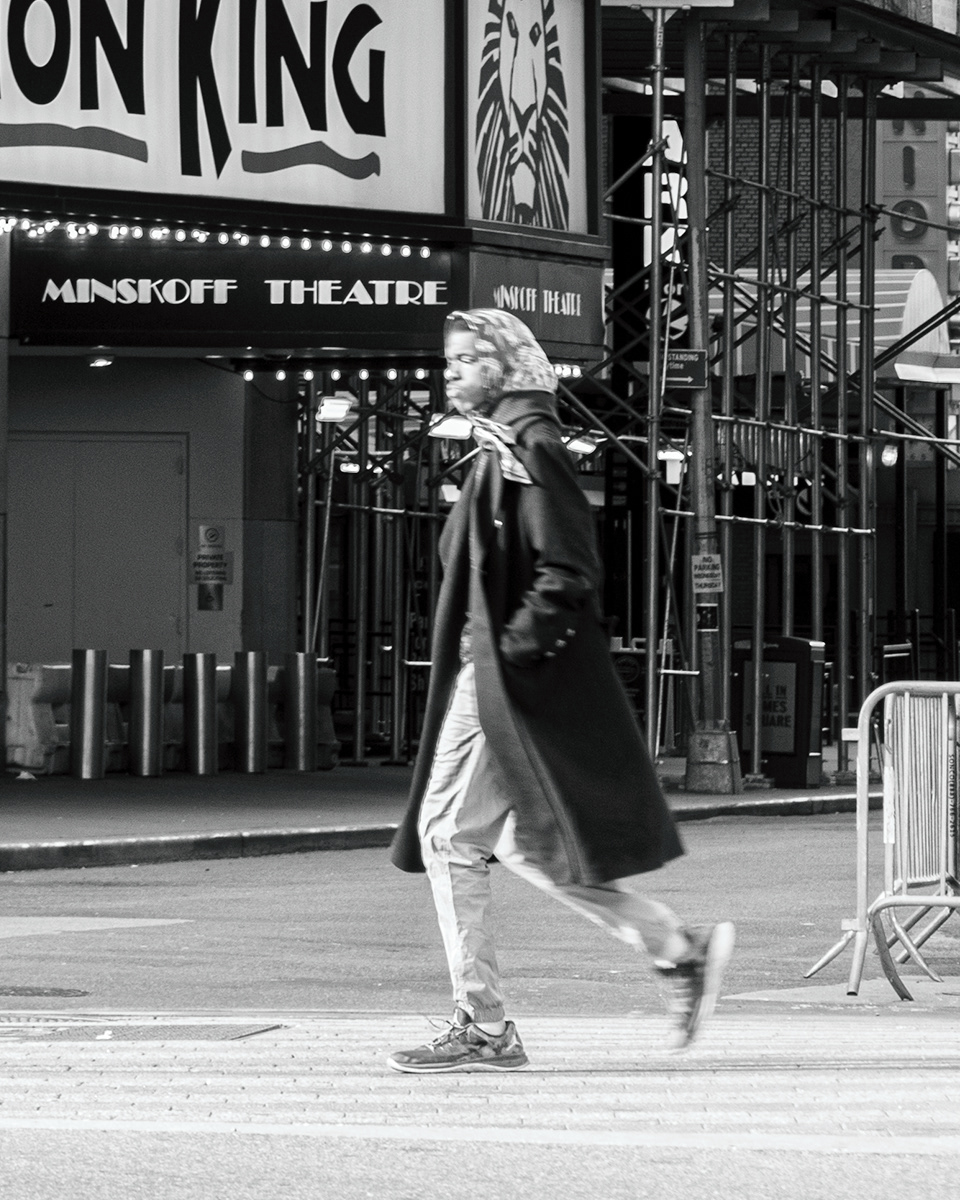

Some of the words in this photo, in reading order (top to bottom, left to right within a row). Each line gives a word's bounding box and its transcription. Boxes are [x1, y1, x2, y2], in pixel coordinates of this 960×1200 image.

[41, 278, 238, 305] MINSKOFF
[264, 279, 448, 306] THEATRE
[746, 712, 792, 728] SUARE
